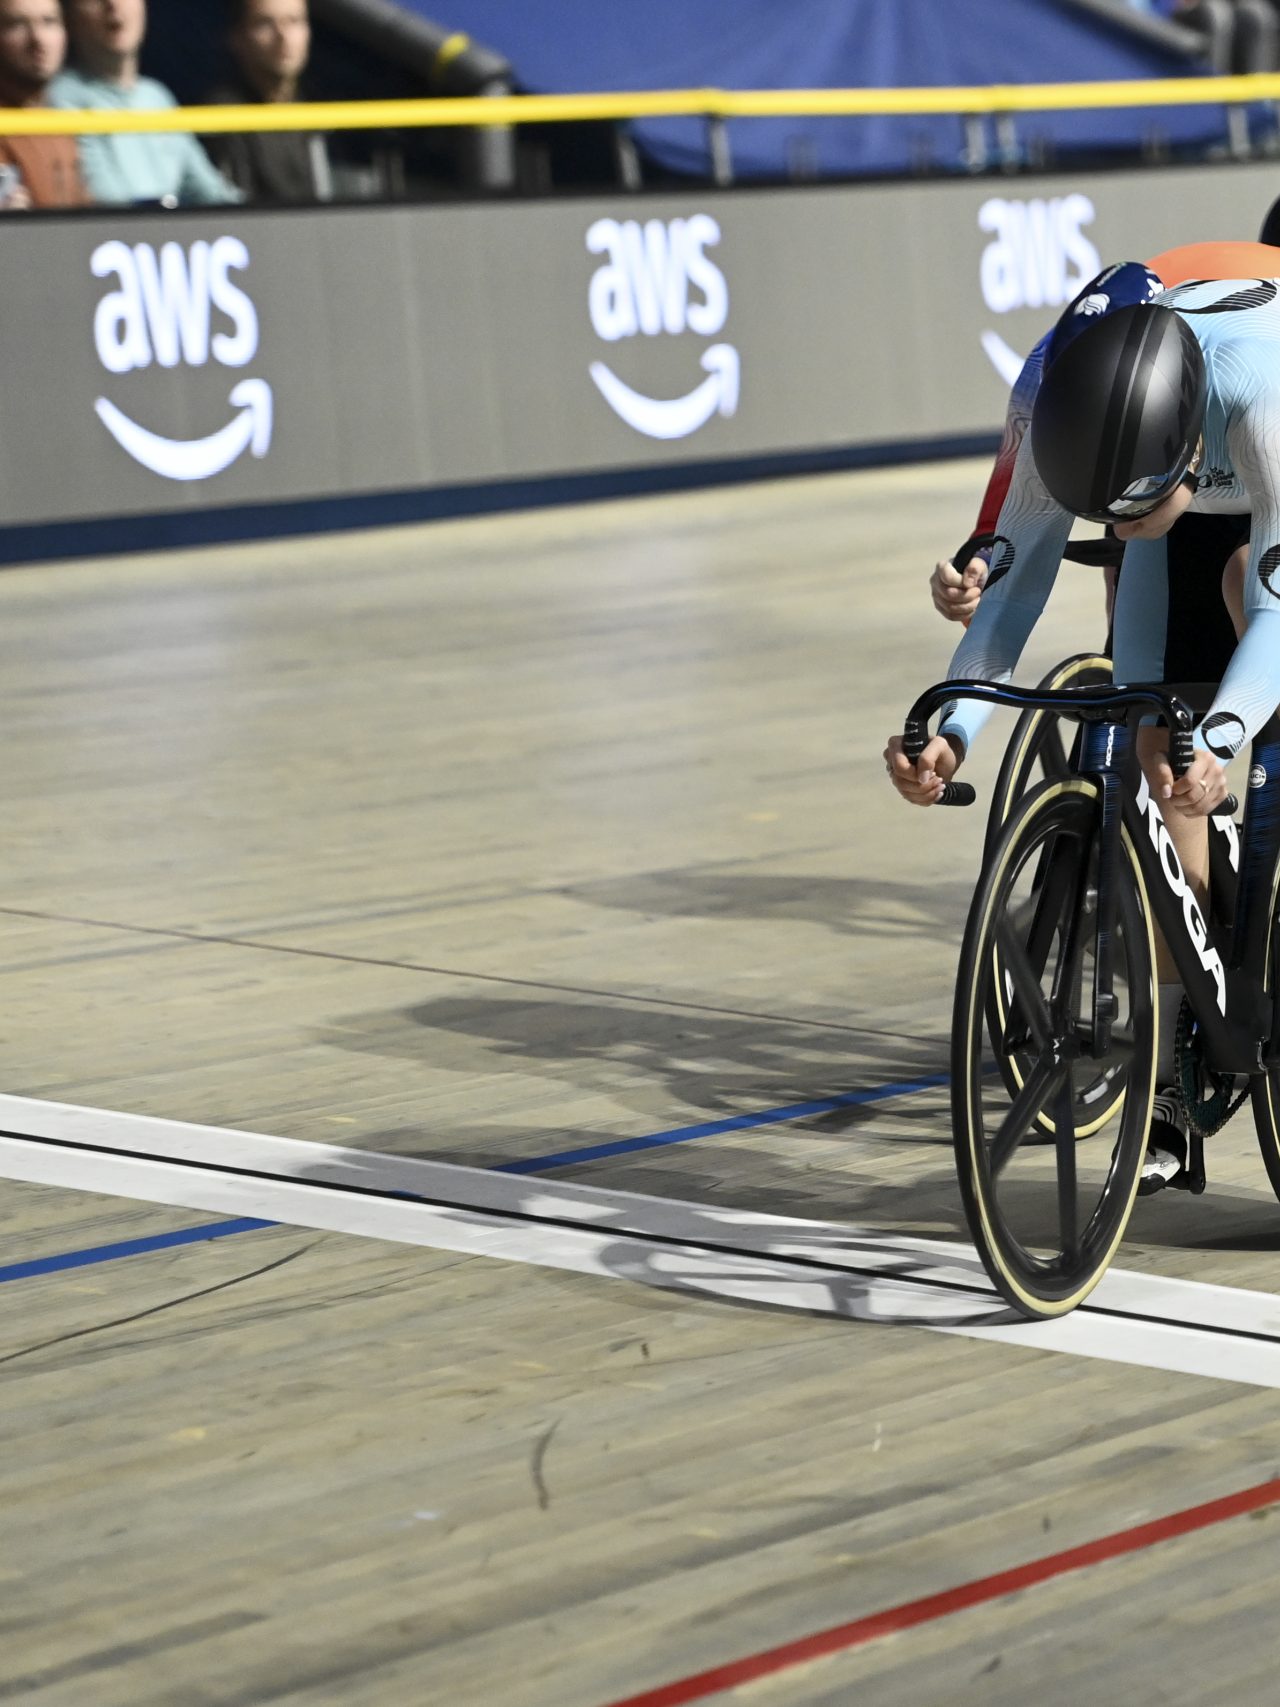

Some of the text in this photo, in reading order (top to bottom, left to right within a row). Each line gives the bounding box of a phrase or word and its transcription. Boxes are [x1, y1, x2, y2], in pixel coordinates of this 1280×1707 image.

[91, 235, 259, 373] aws
[586, 214, 729, 341] aws
[979, 194, 1102, 313] aws
[1135, 769, 1227, 1018] KOGA
